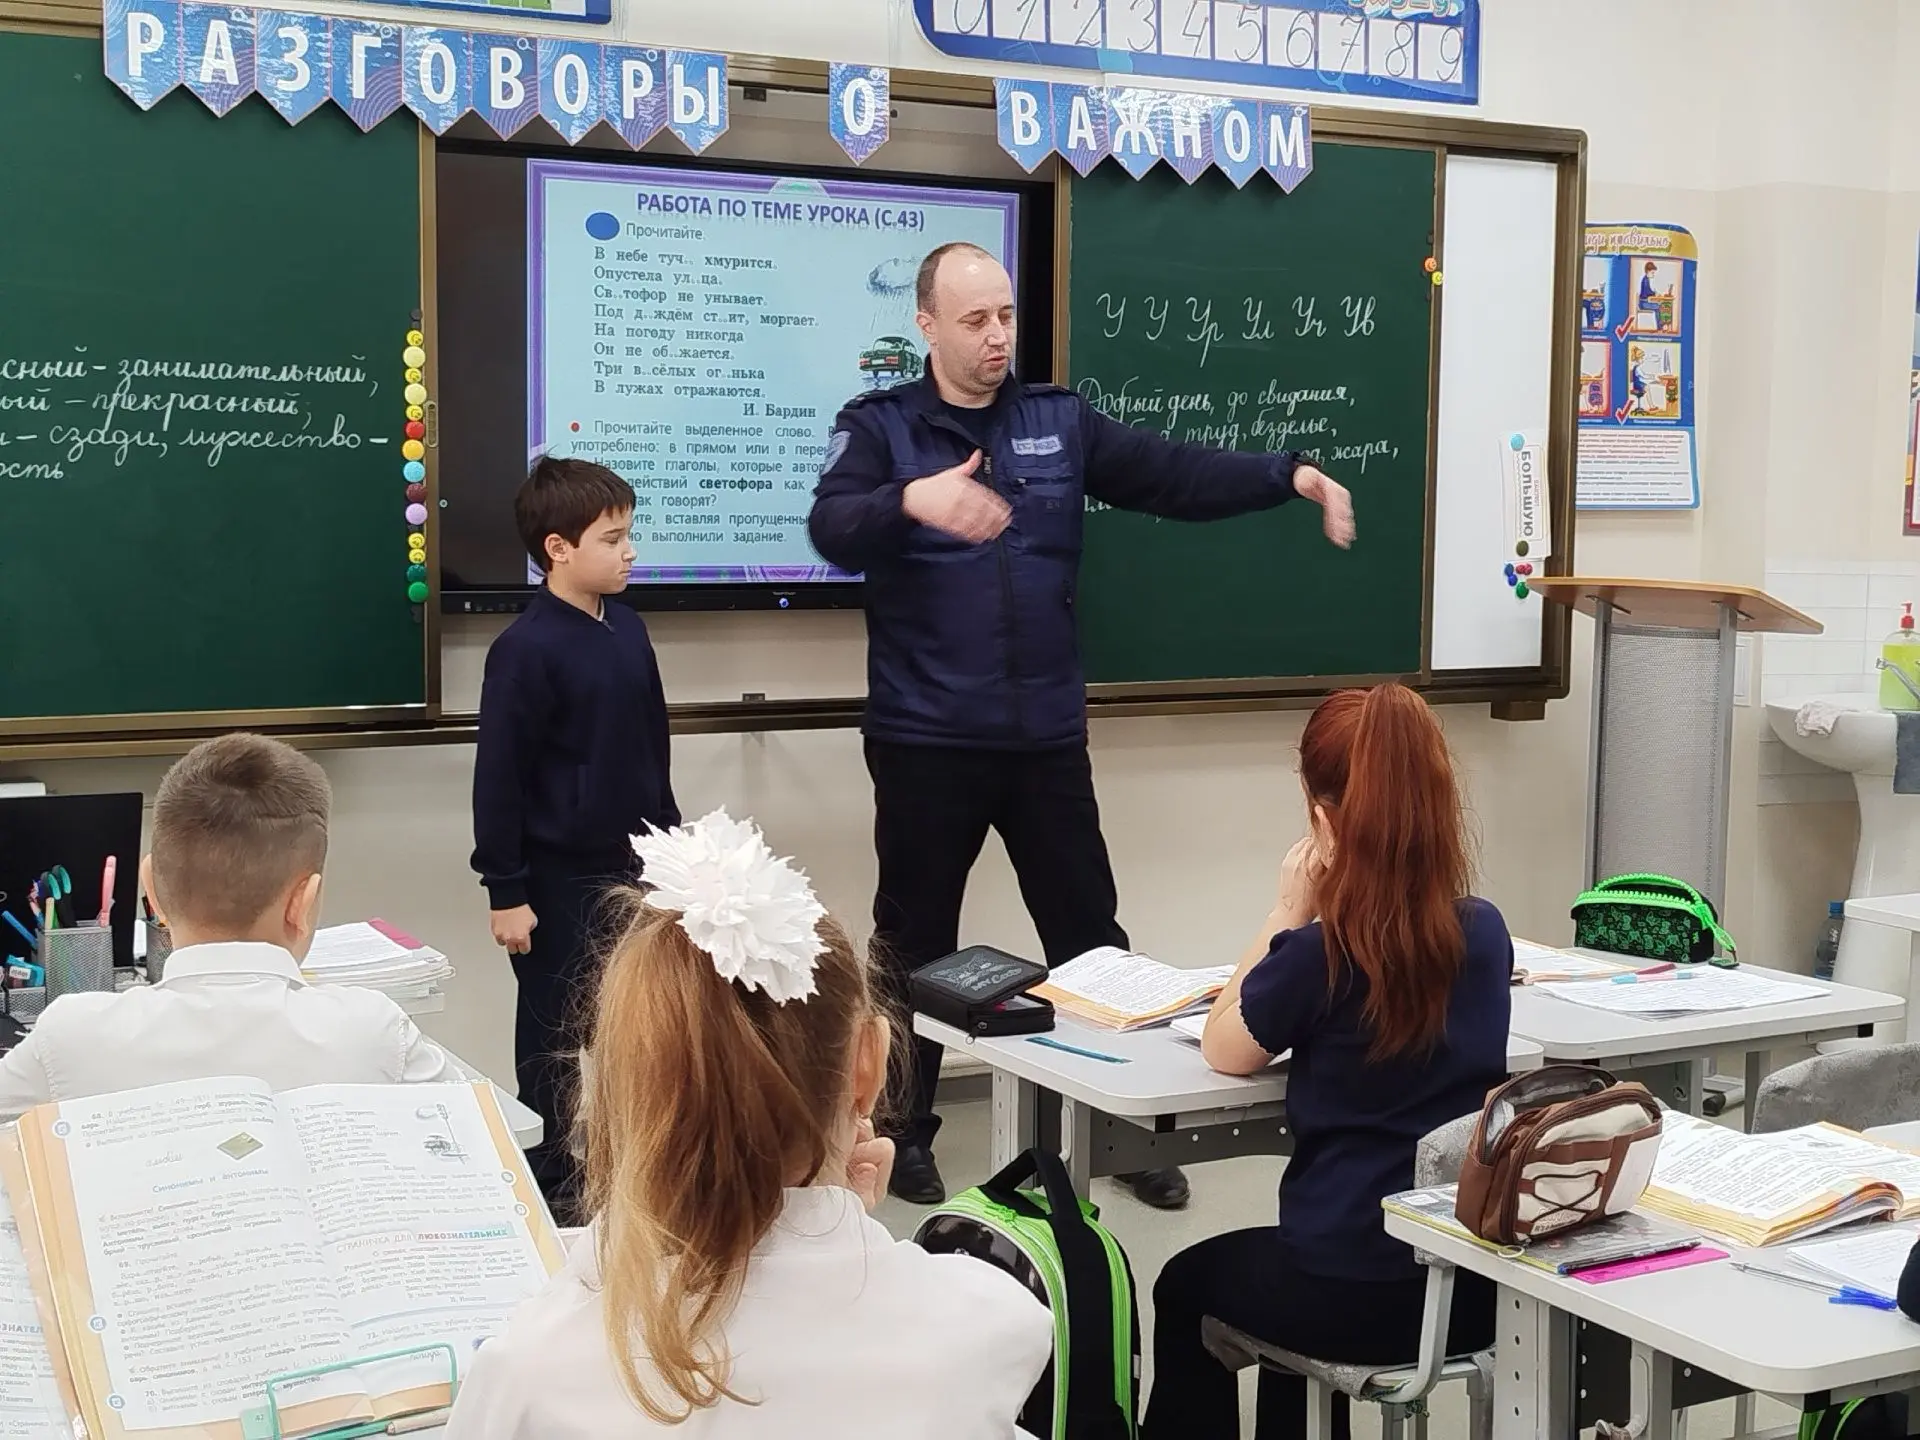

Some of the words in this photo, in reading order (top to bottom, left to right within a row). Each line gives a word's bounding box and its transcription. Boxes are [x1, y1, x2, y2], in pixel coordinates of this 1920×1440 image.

[1127, 0, 1156, 52] 3
[1182, 0, 1209, 57] 4
[1234, 5, 1262, 62] 5
[1286, 10, 1315, 68] 6
[1339, 15, 1364, 72] 7
[1385, 21, 1413, 77] 8
[1436, 26, 1463, 82] 9
[127, 12, 720, 127] РАЗГОВОРЫ
[842, 78, 874, 135] О
[1010, 90, 1307, 169] ВАЖНОМ
[637, 192, 712, 216] РАБОТА
[718, 198, 747, 216] ПО
[752, 201, 802, 220] ТЕМЕ
[808, 204, 870, 226] УРОКА
[875, 207, 925, 232] (С.43)
[594, 246, 605, 260] В
[616, 249, 648, 263] небе
[594, 266, 663, 283] Опустела
[678, 292, 694, 302] не
[594, 304, 624, 319] Под
[594, 323, 616, 337] На
[626, 327, 676, 341] погоду
[686, 329, 744, 343] никогда
[1096, 292, 1127, 338] У
[1143, 295, 1170, 341] У
[1185, 296, 1225, 369] Ур
[1242, 296, 1276, 340] Ул
[1291, 295, 1328, 338] Уч
[1340, 295, 1377, 338] Ув
[594, 342, 615, 356] Он
[625, 345, 643, 357] не
[117, 353, 379, 399] занимательный,
[594, 361, 623, 376] Три
[594, 380, 605, 393] В
[615, 382, 664, 395] лужах
[91, 388, 312, 433] прекрасный,
[765, 403, 816, 419] Бардин
[1077, 376, 1164, 424] Добрый
[1166, 394, 1215, 431] день,
[1226, 391, 1249, 424] до
[1257, 378, 1355, 417] свидания,
[594, 420, 673, 436] Прочитайте
[685, 424, 764, 437] выделенное
[1184, 422, 1247, 452] труд,
[1250, 406, 1337, 453] безделье,
[50, 425, 168, 468] сзади,
[178, 413, 362, 468] мужество
[571, 438, 660, 454] употреблено:
[669, 443, 677, 453] в
[686, 442, 737, 456] прямом
[746, 444, 770, 455] или
[779, 445, 786, 455] в
[1330, 439, 1399, 475] жара,
[665, 460, 720, 474] глаголы,
[730, 461, 783, 475] которые
[698, 476, 773, 492] светофора
[784, 480, 805, 490] как
[636, 495, 652, 507] ак
[661, 493, 717, 509] говорят?
[1521, 450, 1534, 537] БОЛЬШУЮ
[665, 514, 720, 525] вставляя
[729, 514, 808, 527] пропущенны
[651, 532, 724, 542] выполнили
[417, 1229, 509, 1241] ЛЮБОЗНАТЕЛЬНЫХ
